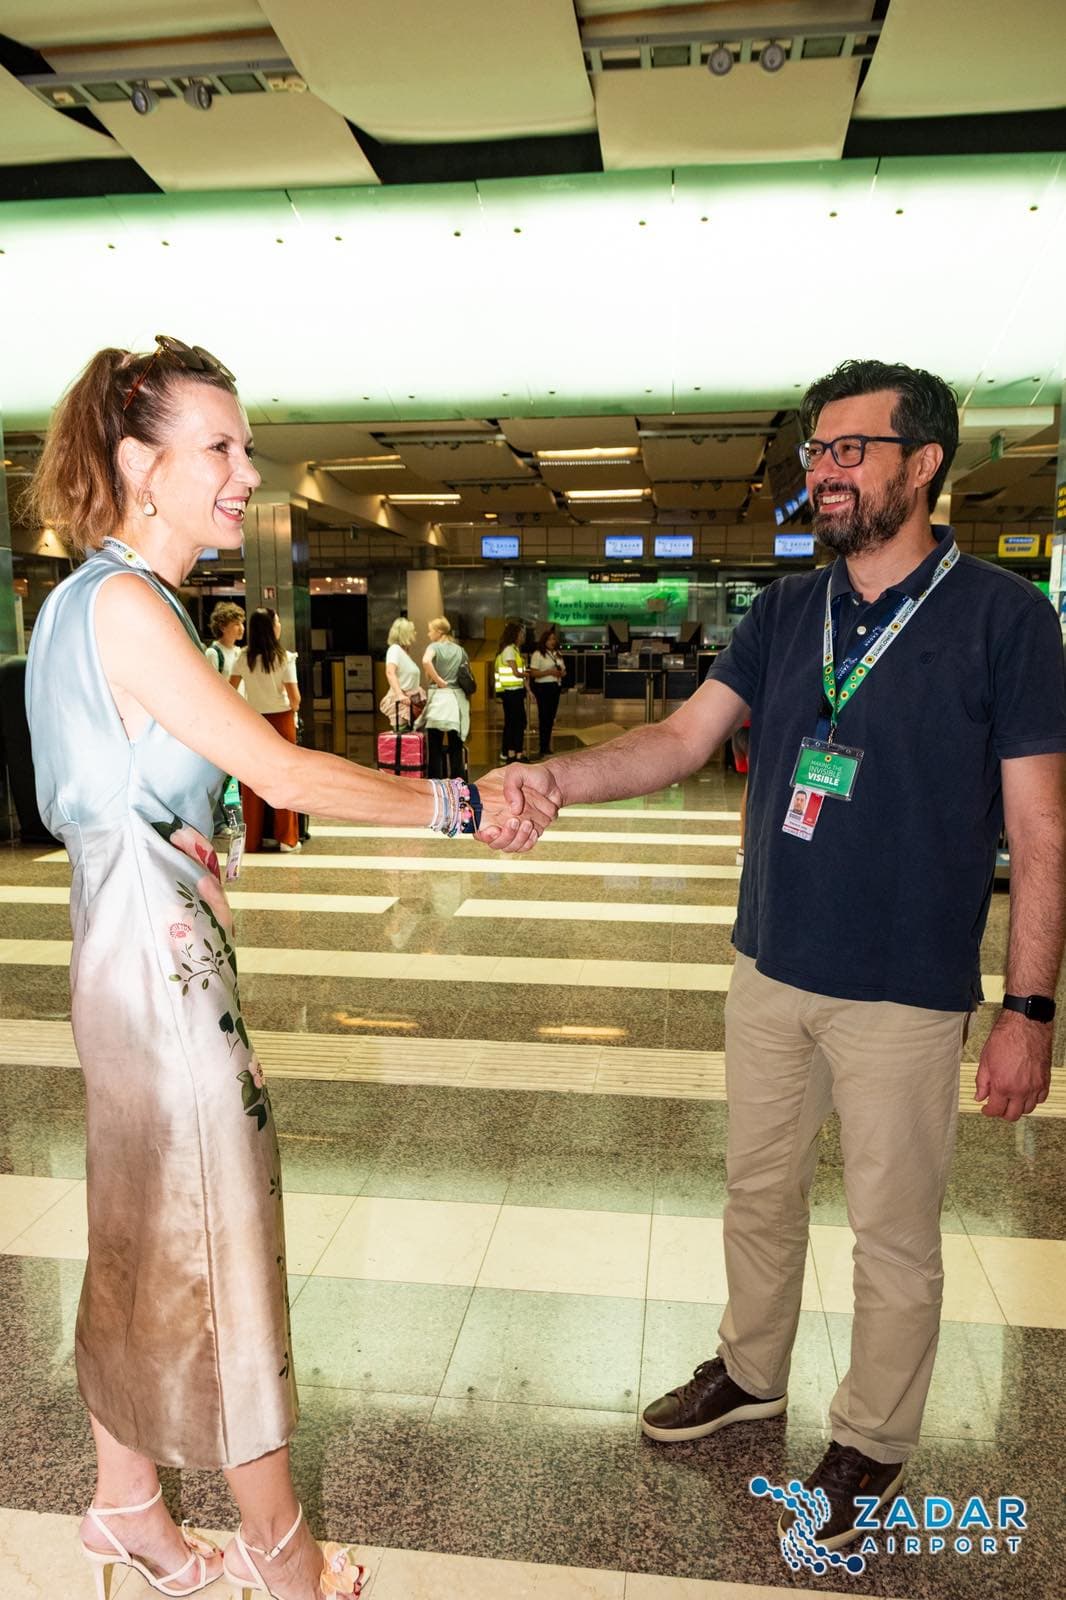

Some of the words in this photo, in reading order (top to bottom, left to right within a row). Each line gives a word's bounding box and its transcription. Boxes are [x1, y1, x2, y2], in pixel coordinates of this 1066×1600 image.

[554, 600, 582, 609] Travel
[584, 602, 604, 610] your
[553, 611, 571, 622] Pay
[572, 611, 588, 621] the
[809, 765, 841, 779] INVISIBLE
[808, 772, 841, 786] VISIBLE
